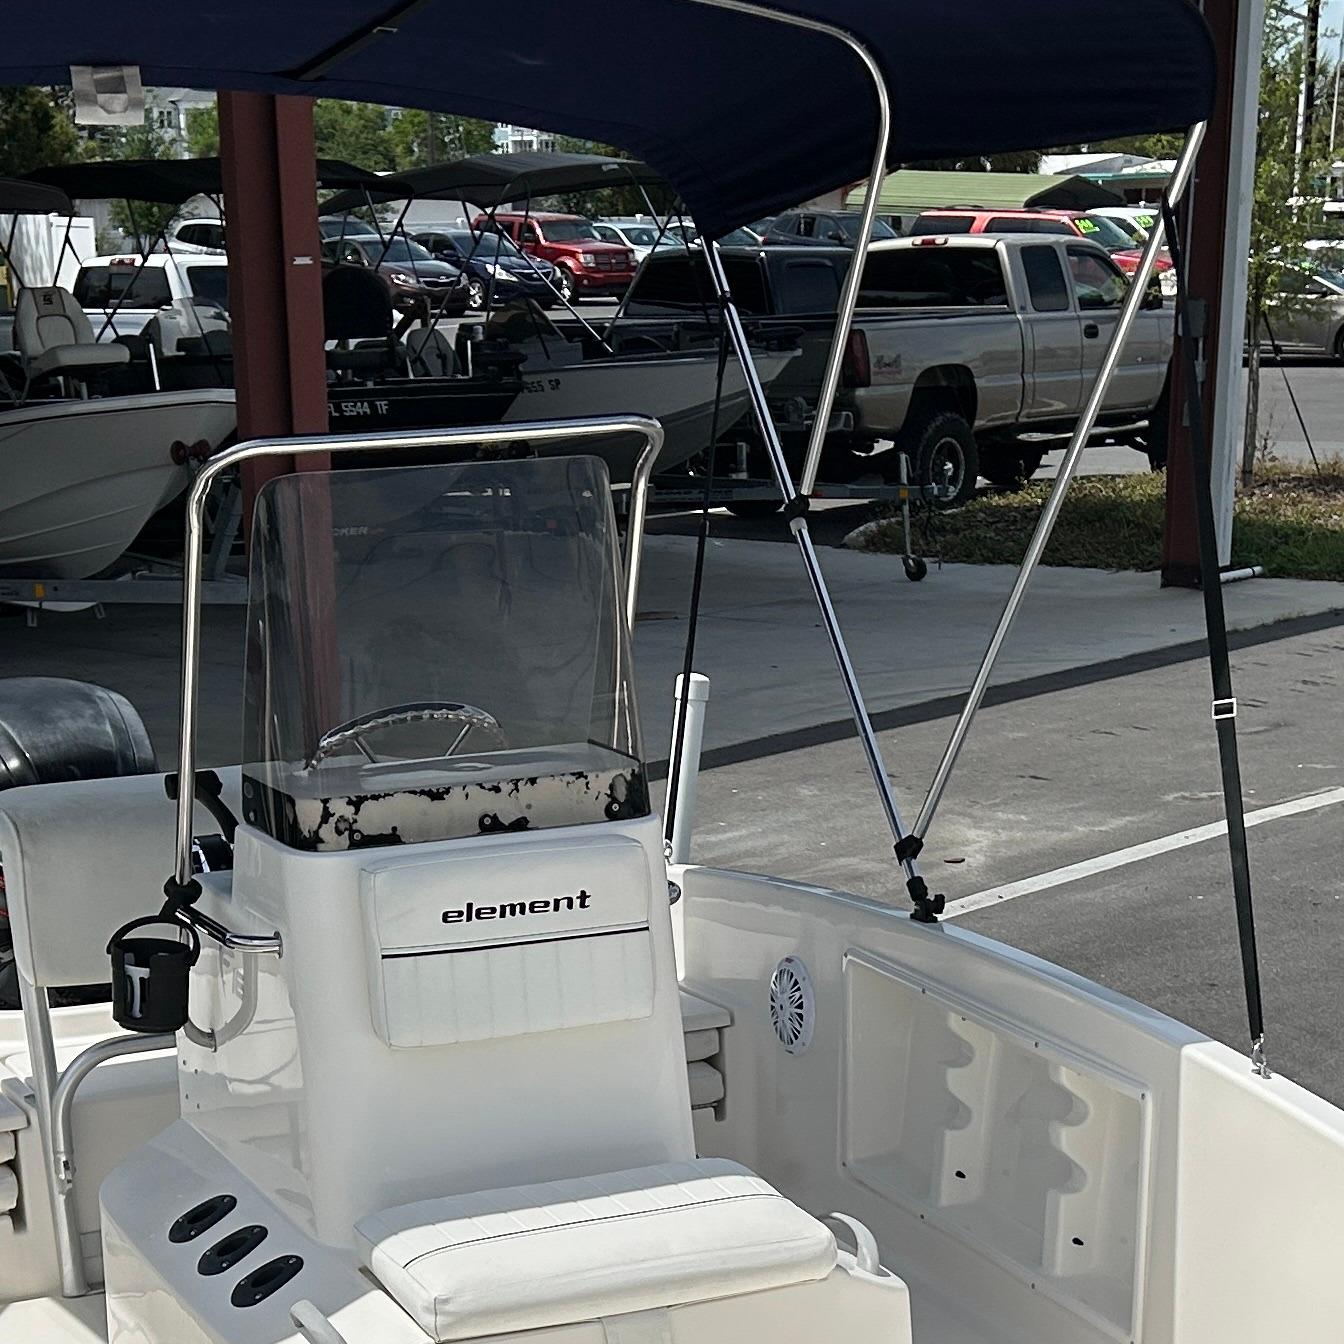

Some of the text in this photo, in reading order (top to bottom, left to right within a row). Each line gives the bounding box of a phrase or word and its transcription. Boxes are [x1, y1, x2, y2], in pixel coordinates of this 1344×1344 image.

[341, 401, 371, 416] 5544
[374, 400, 389, 415] TF
[441, 889, 592, 924] element
